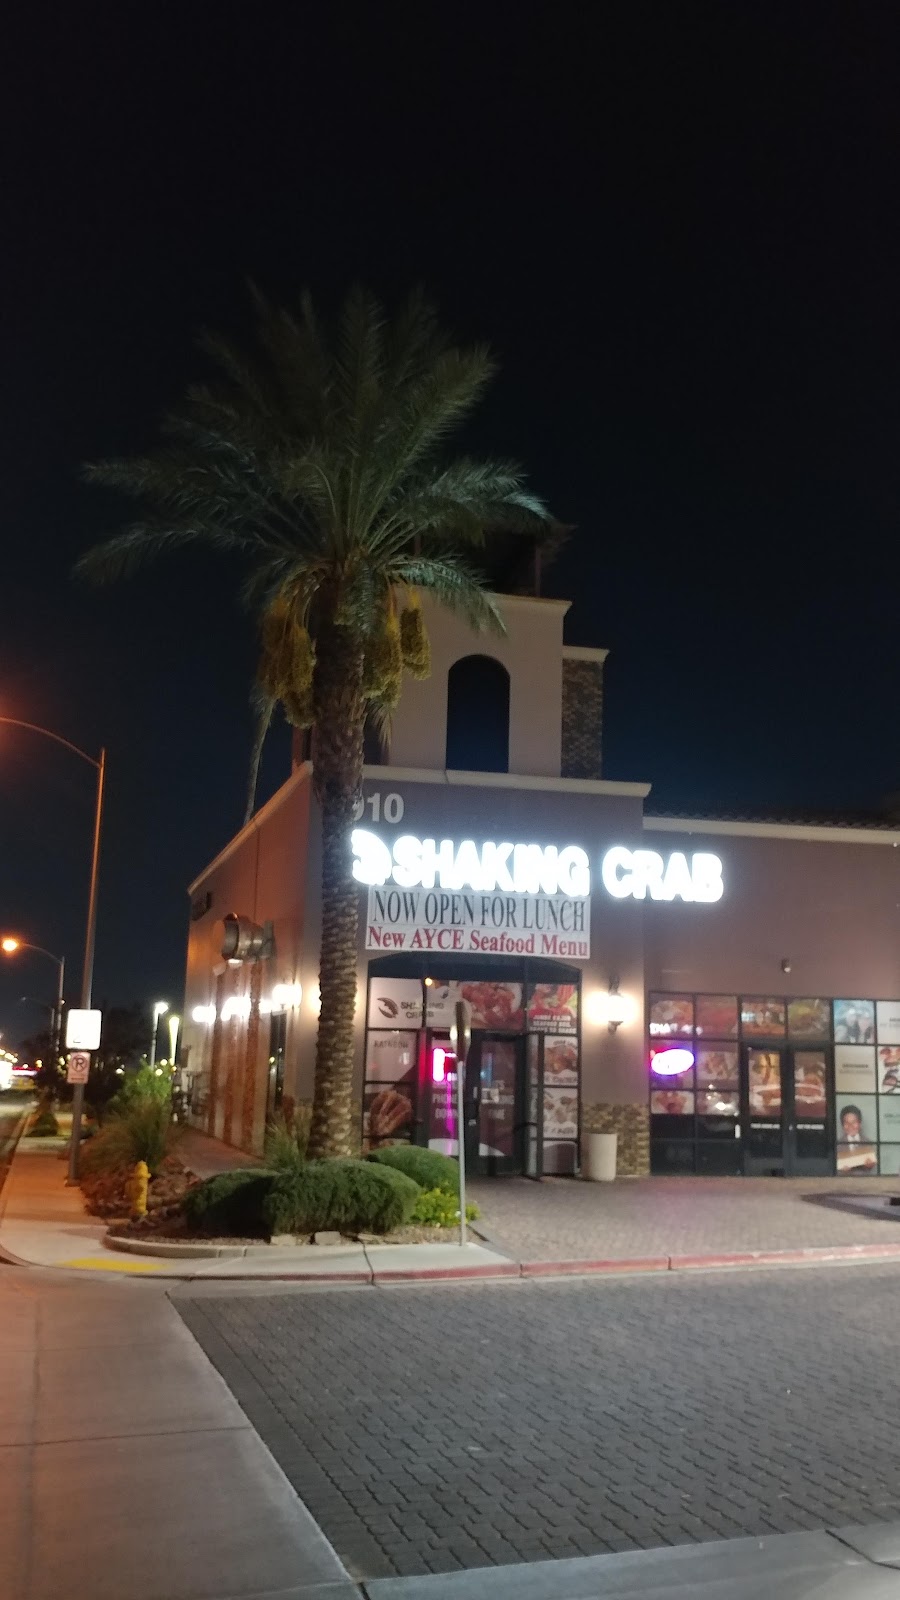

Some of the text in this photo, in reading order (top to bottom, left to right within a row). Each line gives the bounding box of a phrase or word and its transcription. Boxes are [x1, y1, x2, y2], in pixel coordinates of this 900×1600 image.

[391, 835, 724, 903] SHAKING CRAB
[373, 890, 586, 932] NOW OPEN FOR LUNCH
[367, 925, 589, 957] New AYCE Seafood Menu
